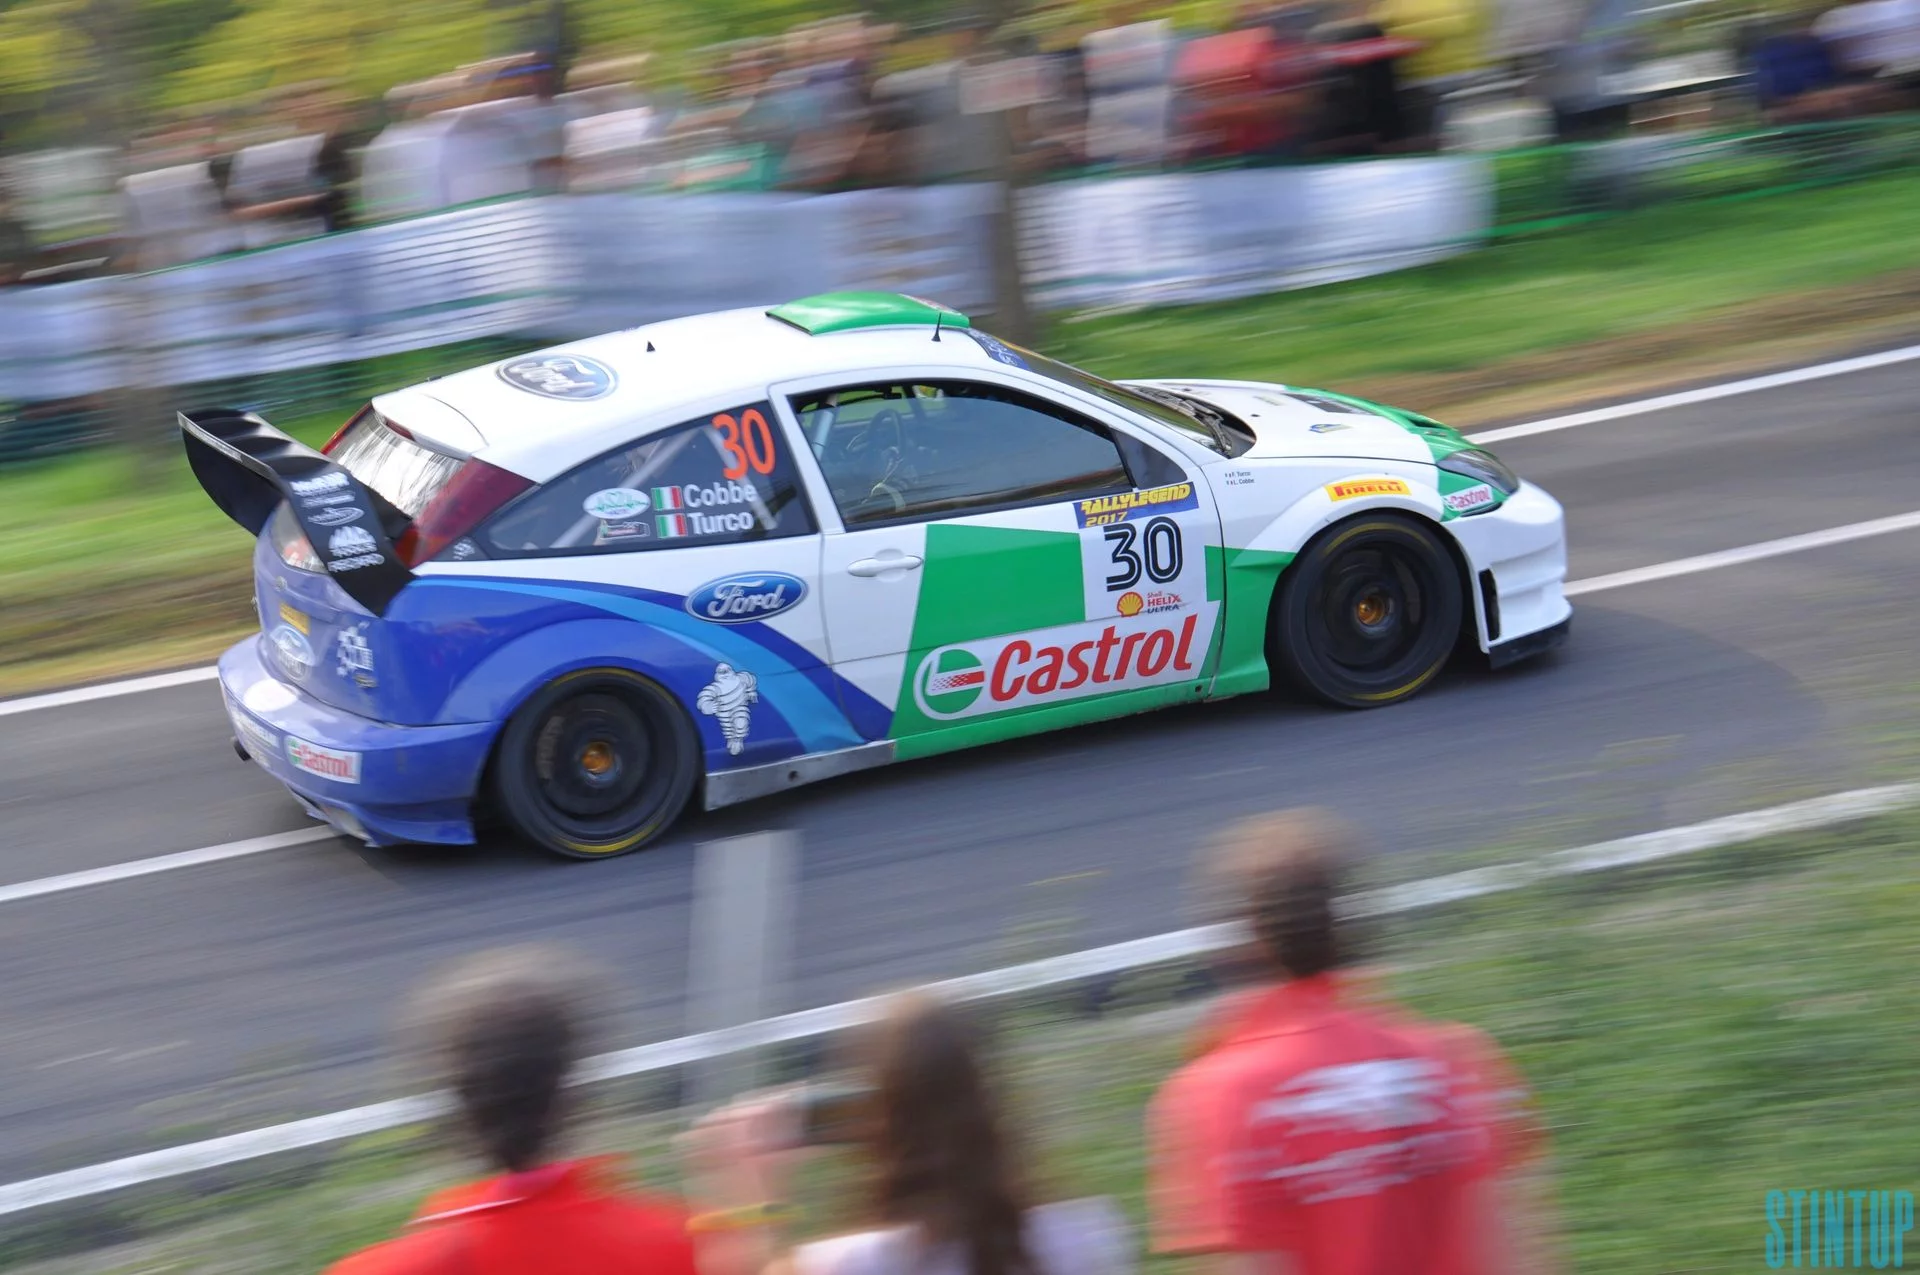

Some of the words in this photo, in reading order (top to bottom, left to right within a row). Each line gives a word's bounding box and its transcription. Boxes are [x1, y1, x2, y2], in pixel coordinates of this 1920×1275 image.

[711, 408, 776, 481] 30
[683, 480, 759, 508] Cobbe
[1081, 484, 1191, 515] RALLYLEGEND
[1332, 481, 1404, 498] PIRELLI
[1449, 486, 1490, 508] Castrol
[687, 511, 754, 535] Turco
[1085, 511, 1128, 528] 2017
[1103, 516, 1183, 592] 30
[707, 579, 786, 617] Ford
[1147, 595, 1182, 607] HELIX
[1147, 604, 1180, 614] ULTRA
[990, 613, 1198, 702] Castrol
